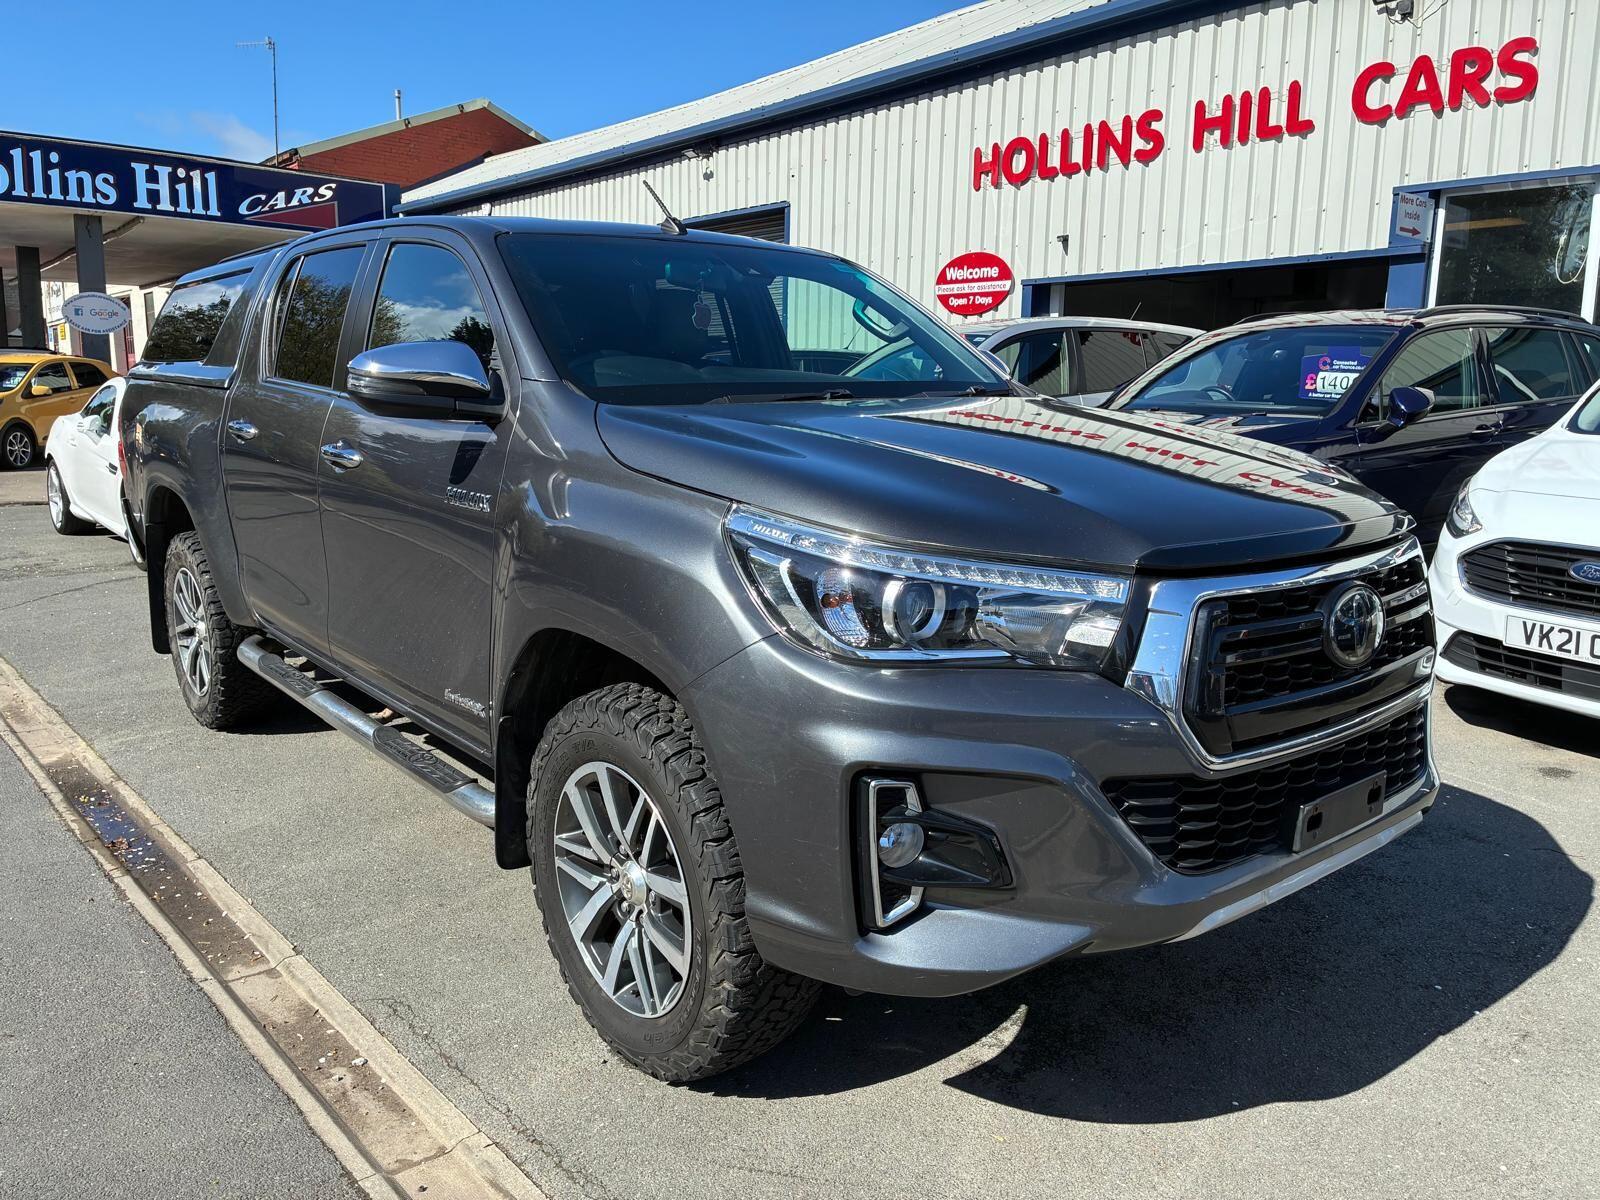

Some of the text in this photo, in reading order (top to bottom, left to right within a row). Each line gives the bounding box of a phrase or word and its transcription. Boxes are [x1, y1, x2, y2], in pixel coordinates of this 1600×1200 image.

[972, 36, 1539, 191] HOLLINS HILL CARS
[131, 161, 221, 217] Hill
[238, 183, 337, 215] CARS
[1400, 194, 1427, 208] More Cars
[1404, 209, 1420, 221] Inside
[945, 265, 999, 280] Welcome
[937, 285, 955, 293] Please
[976, 282, 1007, 291] assistance
[948, 295, 993, 308] Open 7 Days
[89, 308, 119, 319] Google
[752, 523, 790, 540] HILUX
[1522, 620, 1581, 656] VK21
